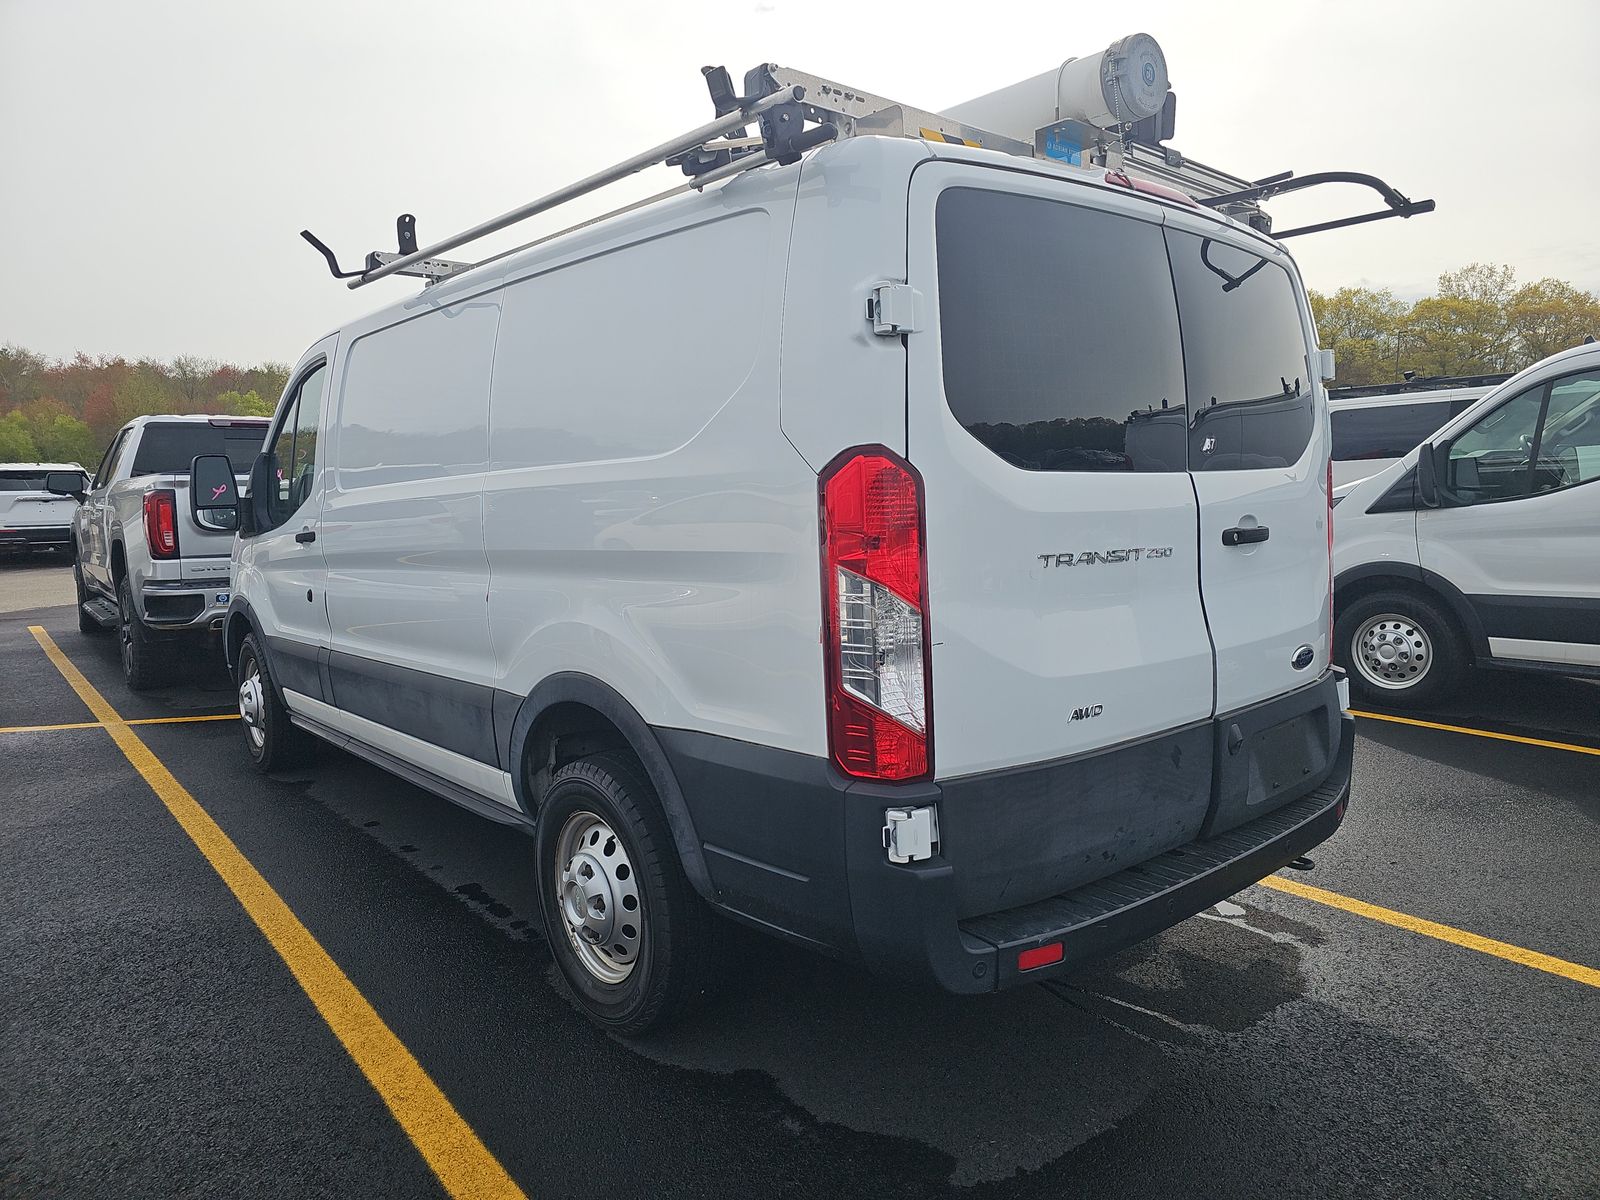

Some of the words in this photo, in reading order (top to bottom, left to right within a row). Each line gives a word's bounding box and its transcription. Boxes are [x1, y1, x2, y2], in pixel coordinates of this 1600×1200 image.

[1037, 547, 1146, 569] TRANSIT
[1146, 546, 1173, 559] 250
[1066, 703, 1104, 723] AWD
